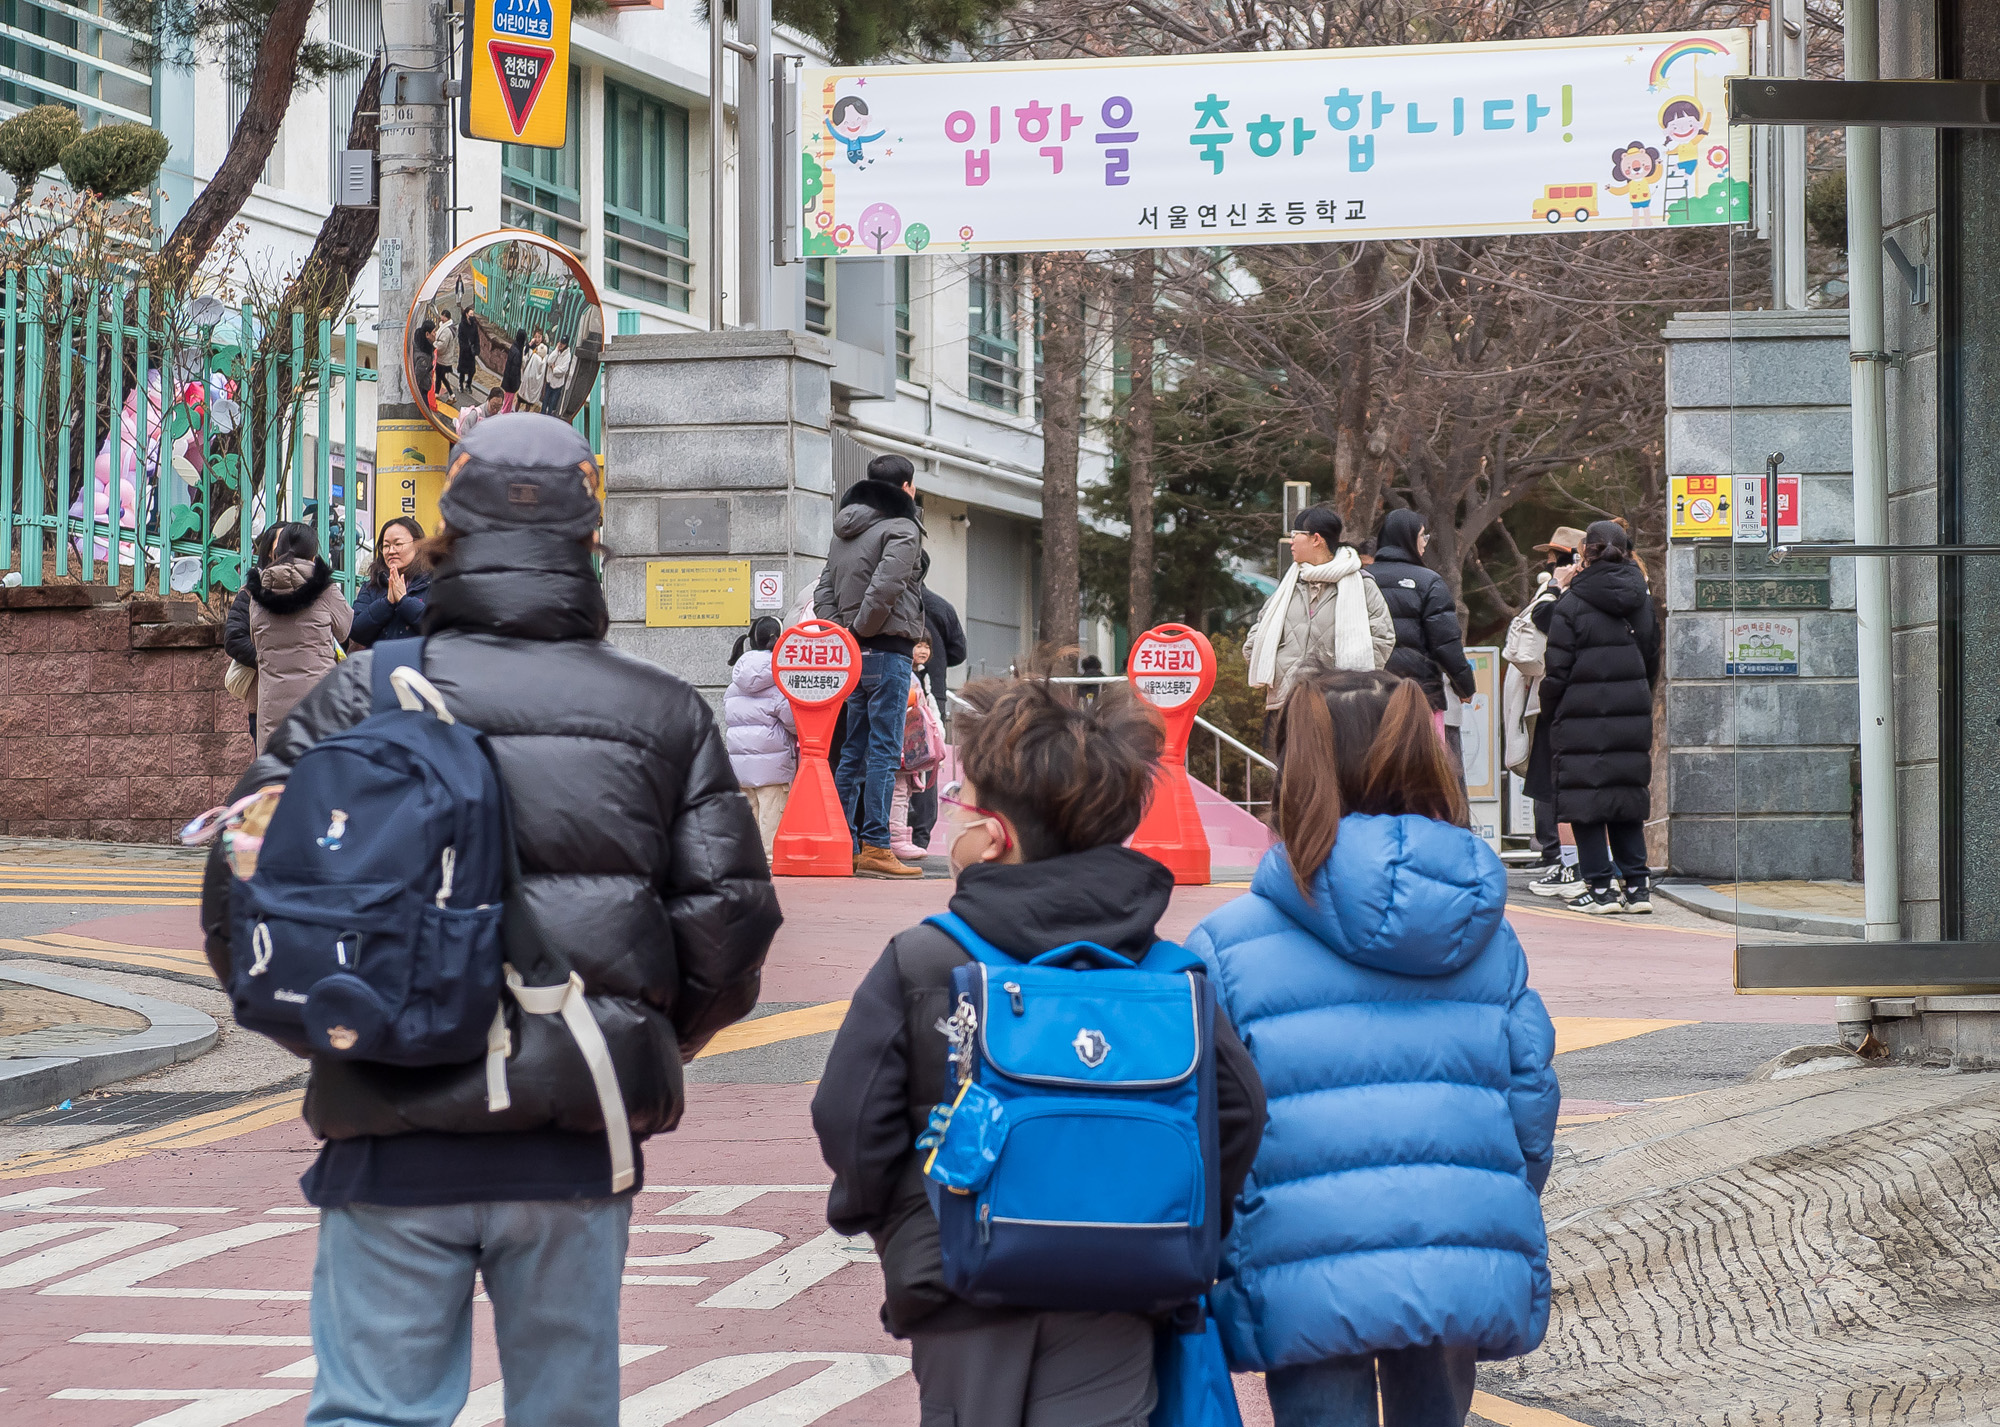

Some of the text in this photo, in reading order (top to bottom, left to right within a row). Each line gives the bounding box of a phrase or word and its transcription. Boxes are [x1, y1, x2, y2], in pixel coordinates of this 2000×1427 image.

[496, 12, 549, 35] 어린이보호
[504, 56, 539, 79] 천천히
[510, 77, 530, 89] SLOW
[944, 84, 1574, 187] 입학을 축하합니다!
[1137, 199, 1368, 231] 서울연신초등학교
[401, 479, 416, 520] 어린
[785, 644, 843, 665] 주차금지
[1140, 650, 1195, 670] 주차금지
[787, 674, 840, 689] 서울연신초등학교
[1144, 681, 1192, 695] 서울연신초등학교
[1560, 867, 1575, 883] NY
